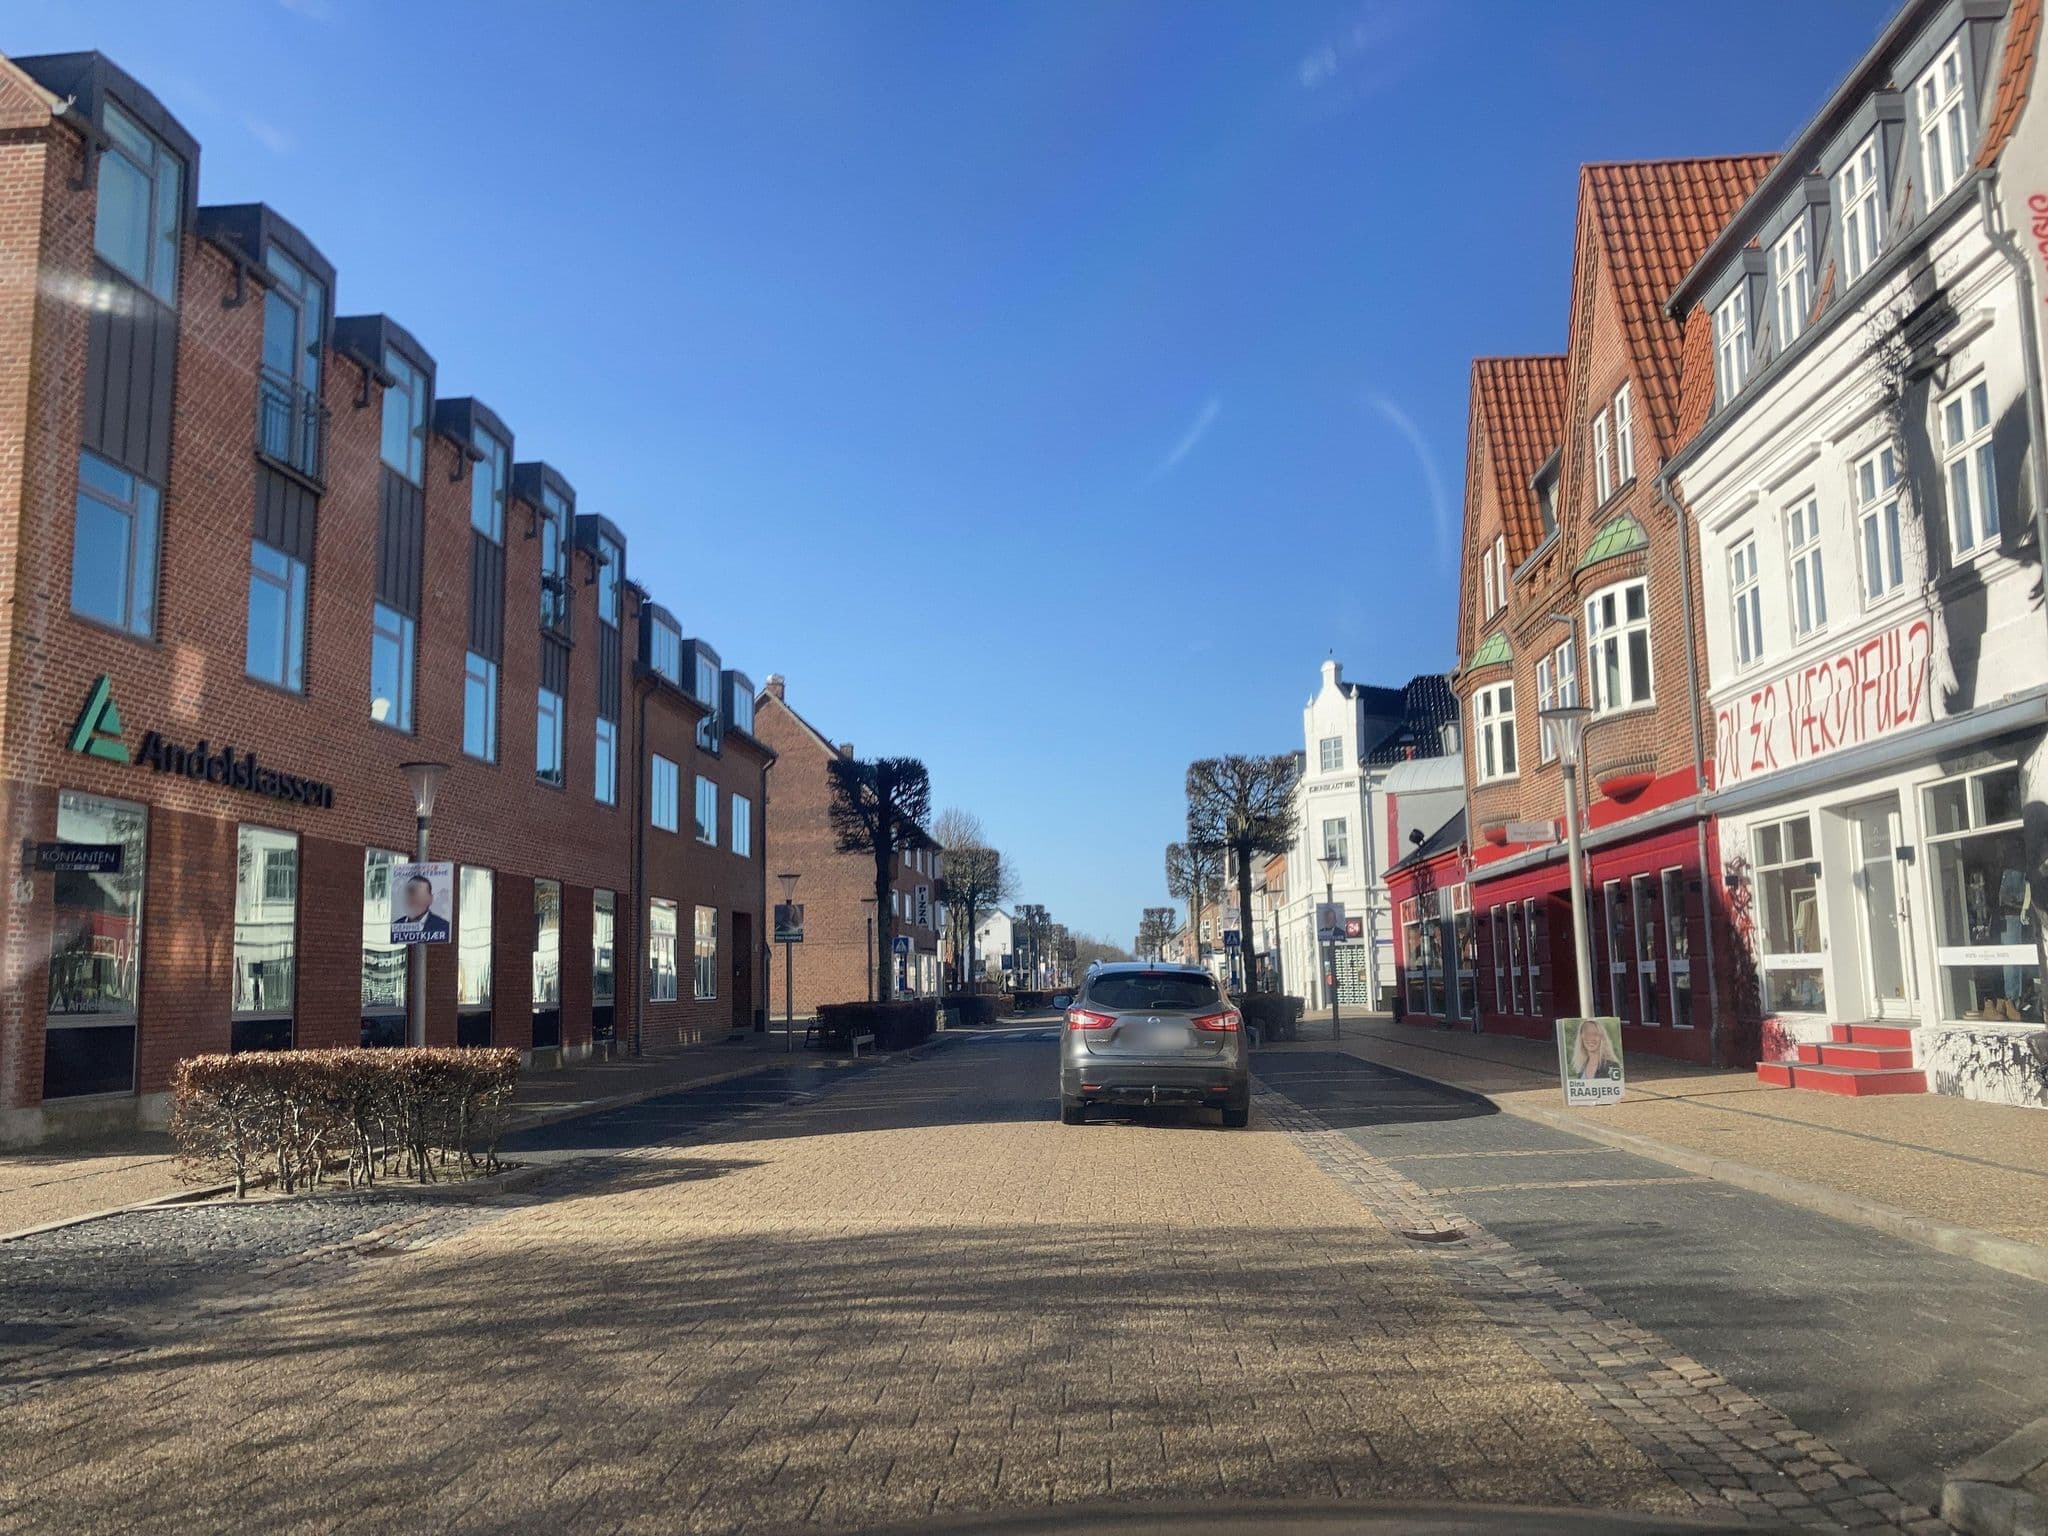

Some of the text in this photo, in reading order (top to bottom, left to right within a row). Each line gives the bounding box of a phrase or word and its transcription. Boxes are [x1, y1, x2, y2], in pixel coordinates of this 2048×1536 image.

[1718, 620, 1930, 786] DU ER VÆRDIFULD
[134, 731, 336, 809] Andelskassen
[918, 886, 928, 925] PIZZA
[393, 931, 446, 942] FLYDTKJÆR
[1570, 1086, 1620, 1098] RAABJERG
